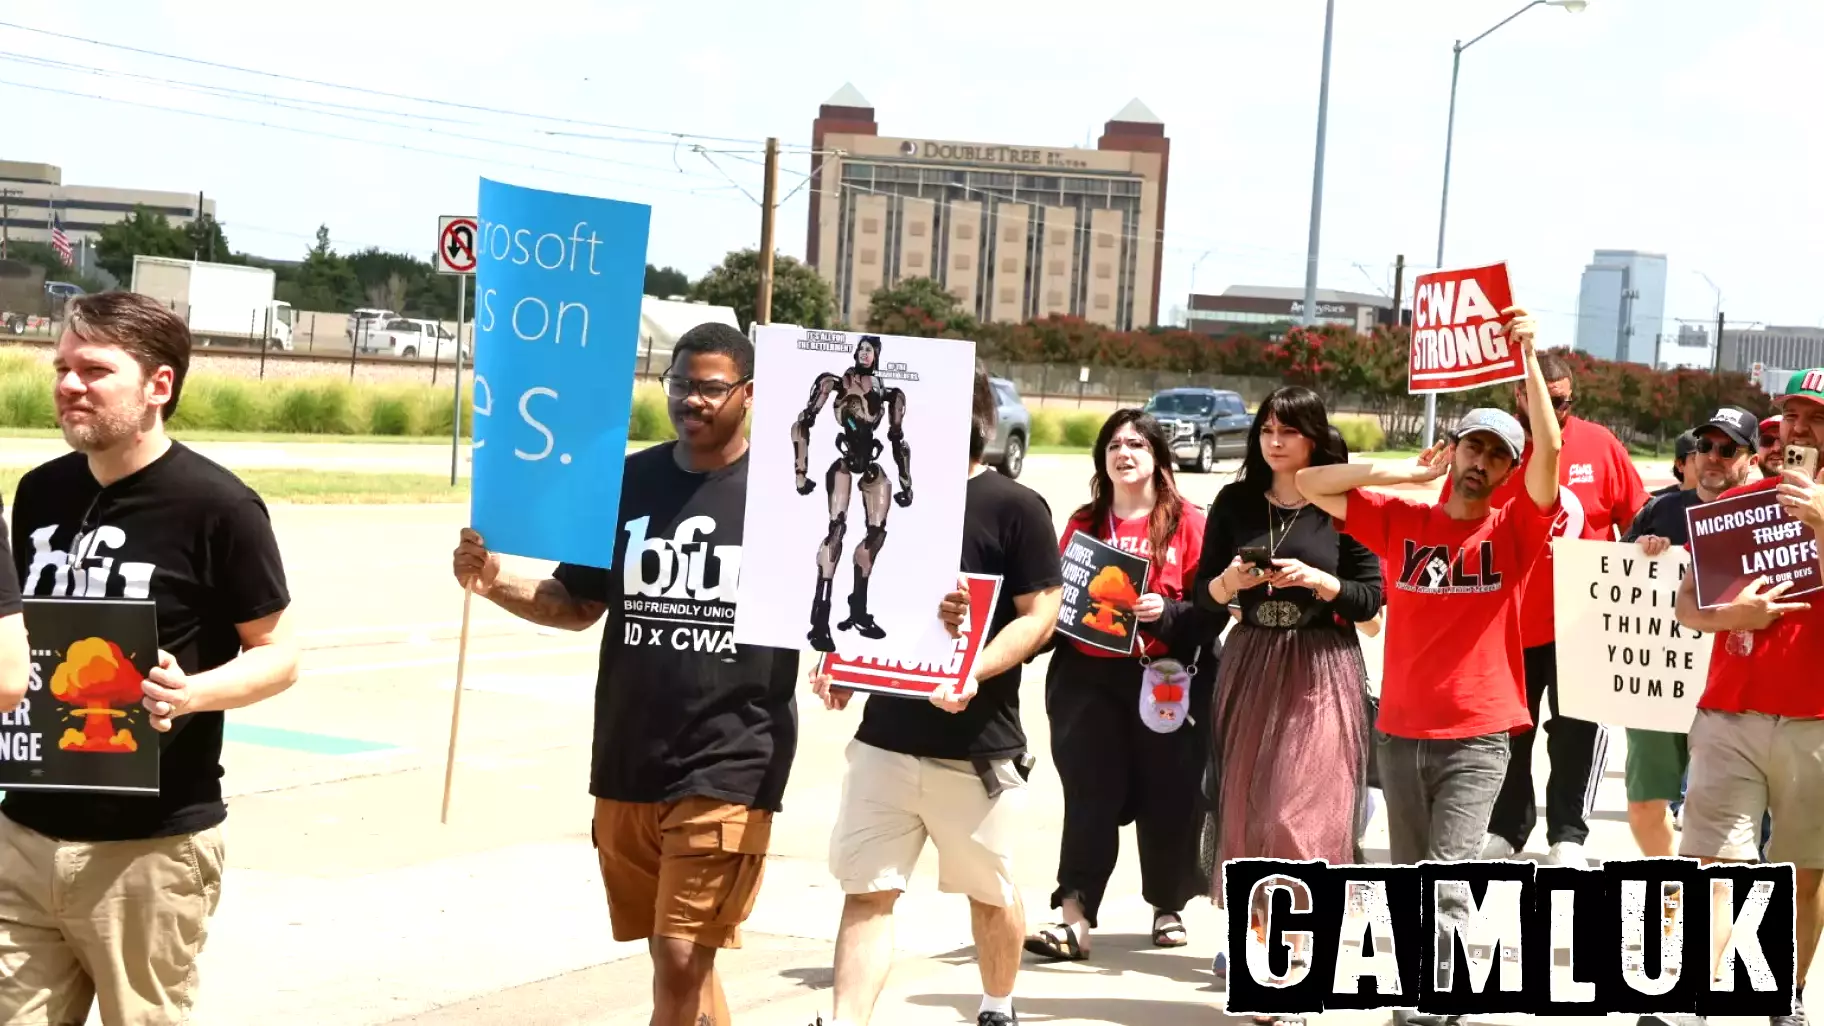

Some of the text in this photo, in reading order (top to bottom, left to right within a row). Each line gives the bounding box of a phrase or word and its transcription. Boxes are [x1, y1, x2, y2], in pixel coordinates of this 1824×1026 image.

[1416, 278, 1500, 329] CWA
[512, 297, 588, 347] on
[1414, 321, 1509, 370] STRONG
[1695, 503, 1782, 537] MICROSOFT
[1752, 520, 1803, 545] TRUST
[623, 515, 743, 604] bfu
[1741, 539, 1819, 575] LAYOFFS
[1775, 571, 1793, 583] OUR
[1793, 566, 1813, 579] DEVS
[624, 600, 643, 611] BIG
[644, 602, 701, 616] FRIENDLY
[671, 627, 738, 654] CWA
[1614, 675, 1684, 698] DUMB
